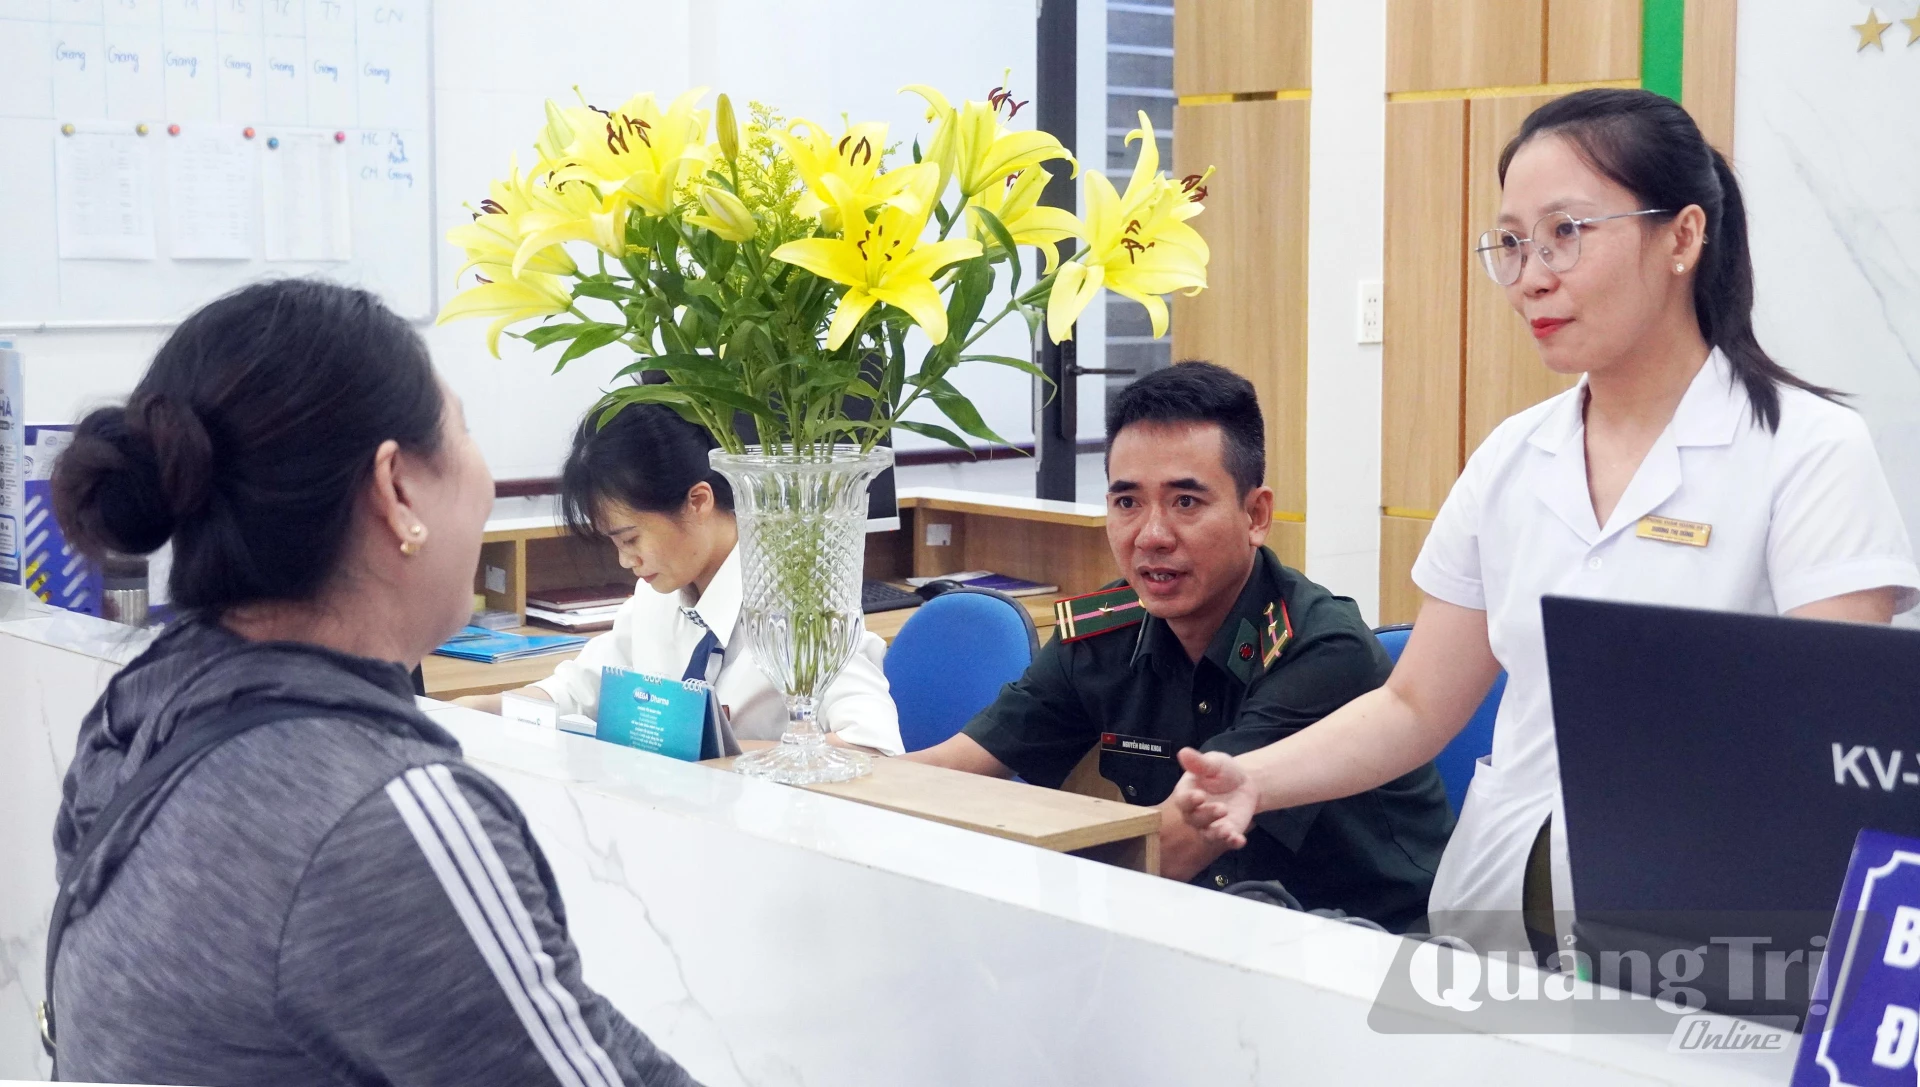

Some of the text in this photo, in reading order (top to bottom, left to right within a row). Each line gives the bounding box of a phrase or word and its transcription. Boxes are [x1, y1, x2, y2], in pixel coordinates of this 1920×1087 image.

[320, 1, 342, 20] T7
[374, 7, 403, 23] CN
[634, 691, 649, 701] MEGA
[1122, 740, 1138, 749] NGUYỄN
[1151, 745, 1162, 753] KHOA
[1831, 742, 1920, 791] KV-
[1872, 1003, 1920, 1072] Đ
